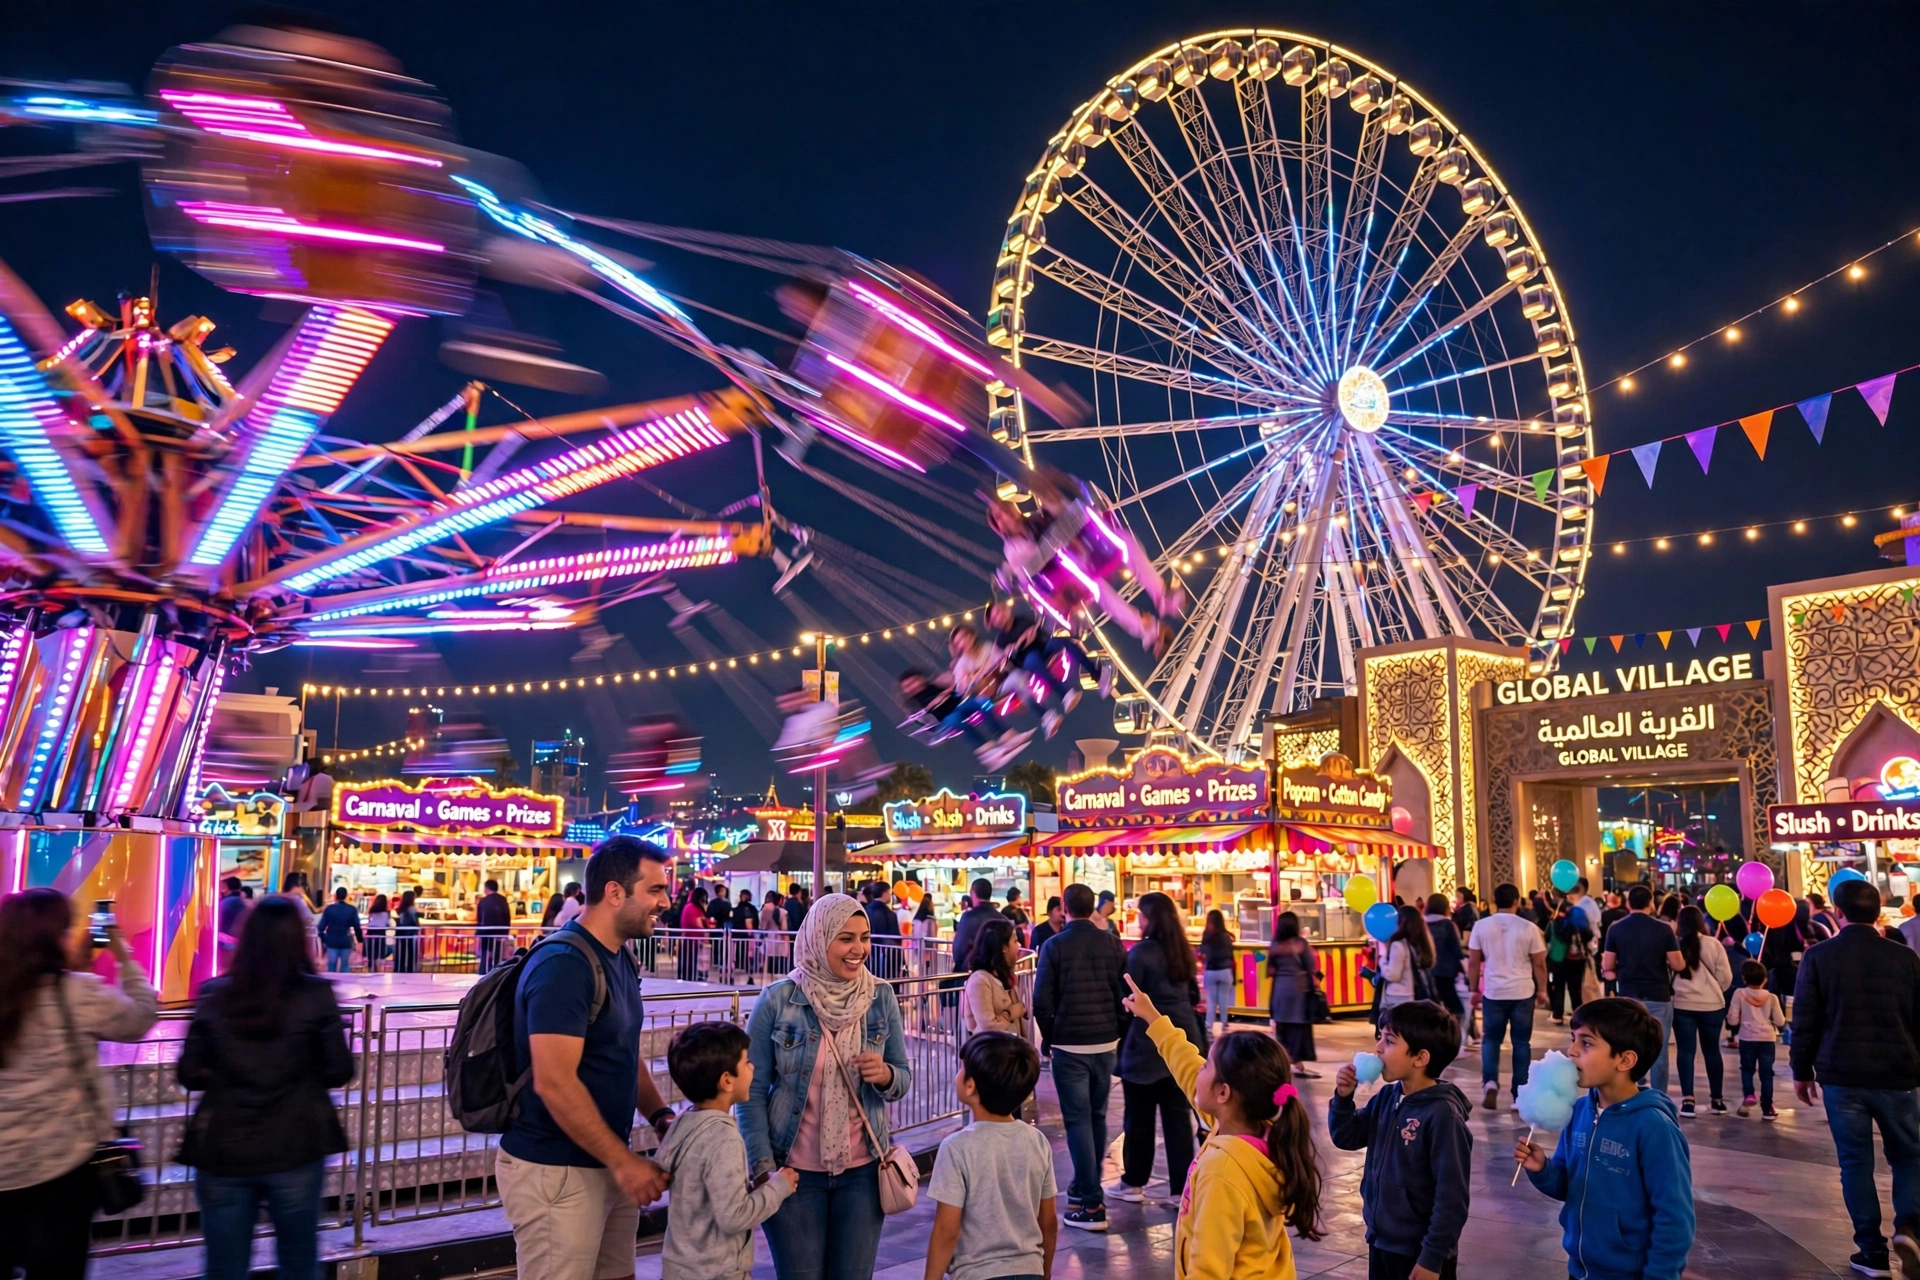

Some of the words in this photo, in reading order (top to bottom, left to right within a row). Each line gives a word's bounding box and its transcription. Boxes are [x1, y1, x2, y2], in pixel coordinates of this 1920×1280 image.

[1497, 671, 1609, 705] GLOBAL
[1616, 653, 1752, 692] VILLAGE
[1537, 712, 1632, 748] العالمية
[1639, 704, 1715, 740] القرية
[1558, 748, 1618, 766] GLOBAL
[1621, 743, 1689, 761] VILLAGE
[345, 795, 420, 819] Carnaval
[437, 800, 490, 822] Games
[506, 803, 551, 824] Prizes
[1065, 785, 1125, 810] Carnaval
[1140, 784, 1190, 806] Games
[1207, 778, 1257, 802] Prizes
[1283, 777, 1320, 807] Popcorn
[1328, 782, 1359, 806] Cotton
[1359, 785, 1386, 813] Candy
[892, 811, 921, 830] Slush
[932, 808, 963, 828] Slush
[975, 805, 1015, 826] Drinks
[1775, 810, 1831, 835] Slush
[1851, 807, 1920, 832] Drinks
